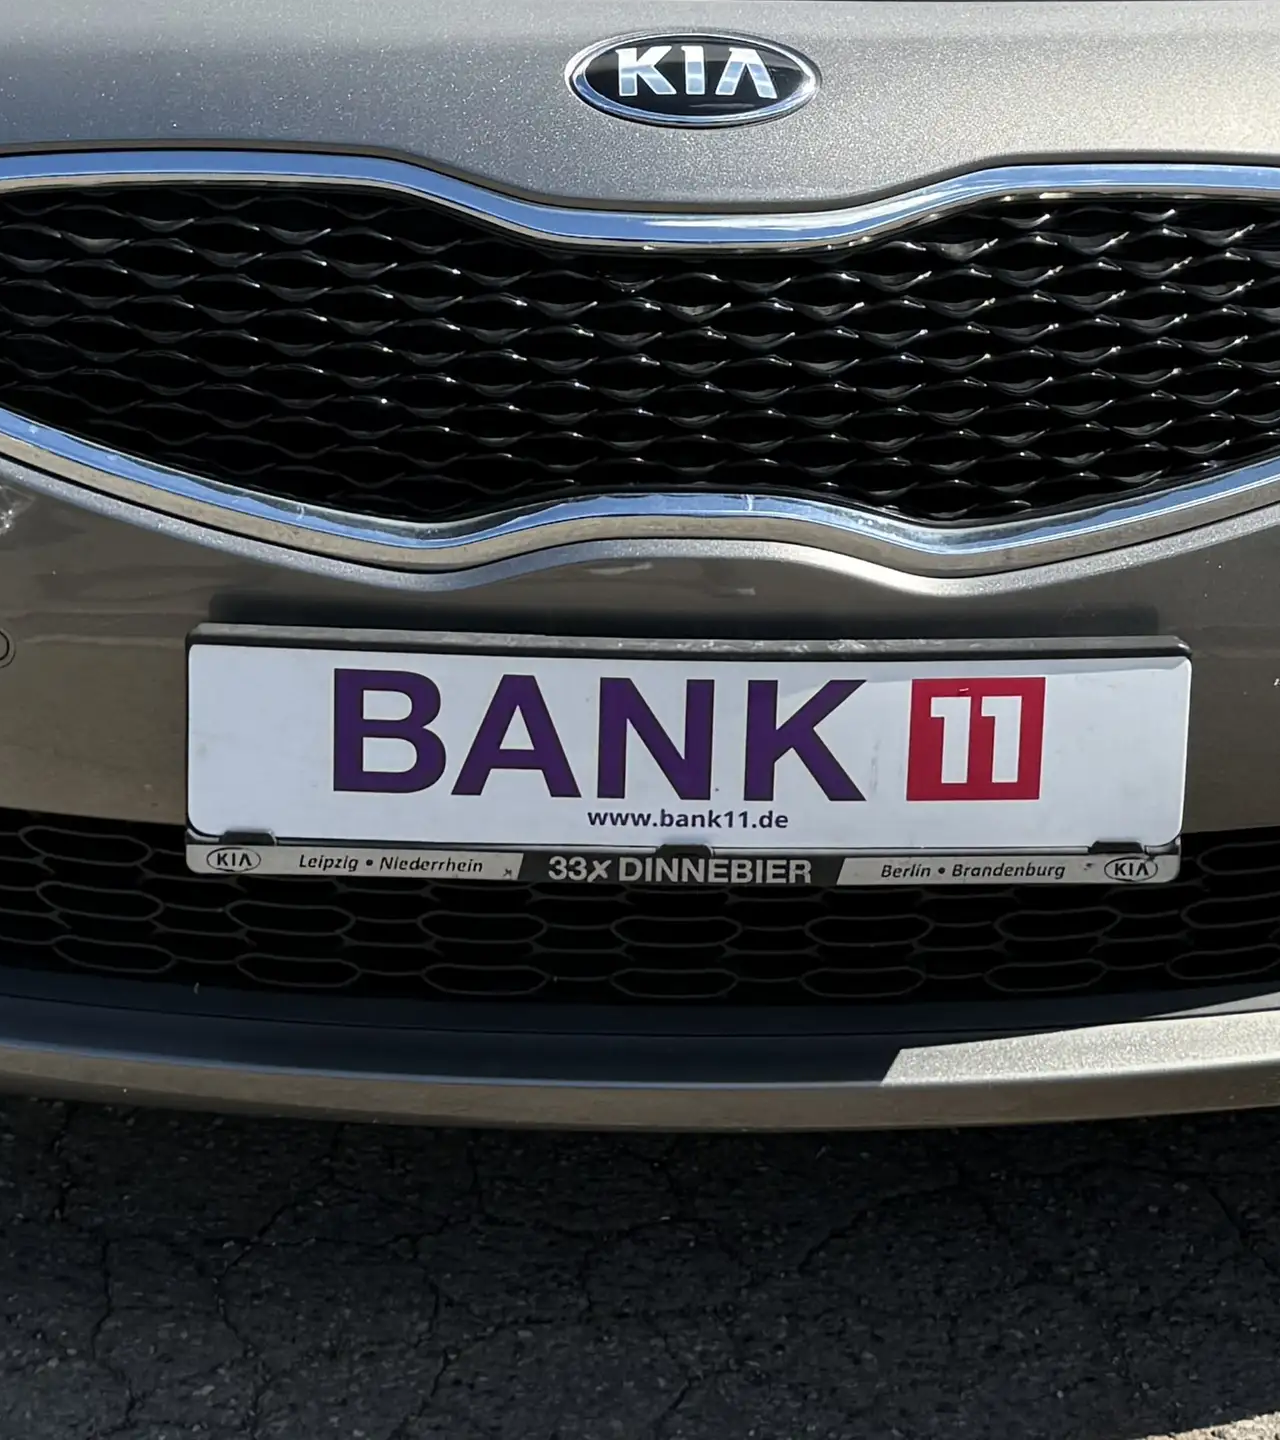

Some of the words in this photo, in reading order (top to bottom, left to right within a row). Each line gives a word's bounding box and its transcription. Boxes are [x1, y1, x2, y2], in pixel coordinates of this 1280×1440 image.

[615, 46, 778, 99] KIA
[332, 667, 867, 801] BANK
[929, 695, 1022, 785] 11
[587, 809, 790, 829] www.bank11.de
[216, 852, 253, 868] KIA
[299, 854, 360, 872] Leipzig
[379, 856, 484, 873] Niederrhein
[619, 857, 812, 884] DINNEBIER
[881, 864, 931, 878] Berlin
[951, 863, 1066, 880] Brandenburg
[1114, 862, 1150, 877] KIA
